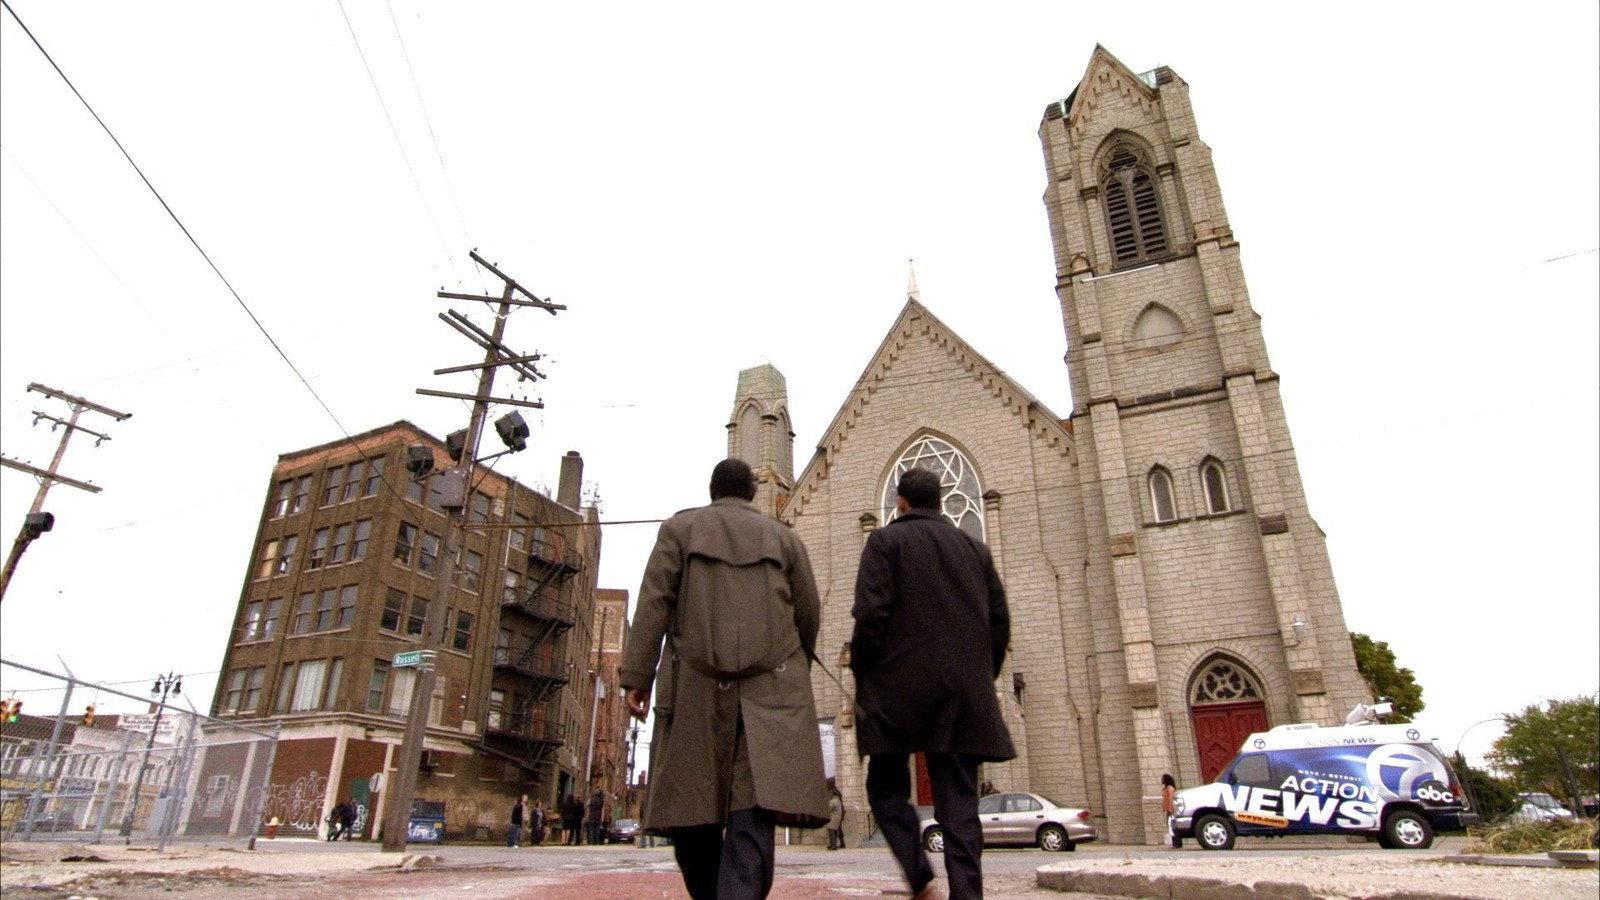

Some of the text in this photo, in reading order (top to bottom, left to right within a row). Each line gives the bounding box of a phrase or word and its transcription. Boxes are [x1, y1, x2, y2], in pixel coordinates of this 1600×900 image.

[395, 653, 420, 664] Russell
[1280, 775, 1378, 802] ACTION
[1417, 785, 1454, 803] abc
[1212, 782, 1377, 828] NEWS
[1237, 813, 1285, 825] wxyz.com
